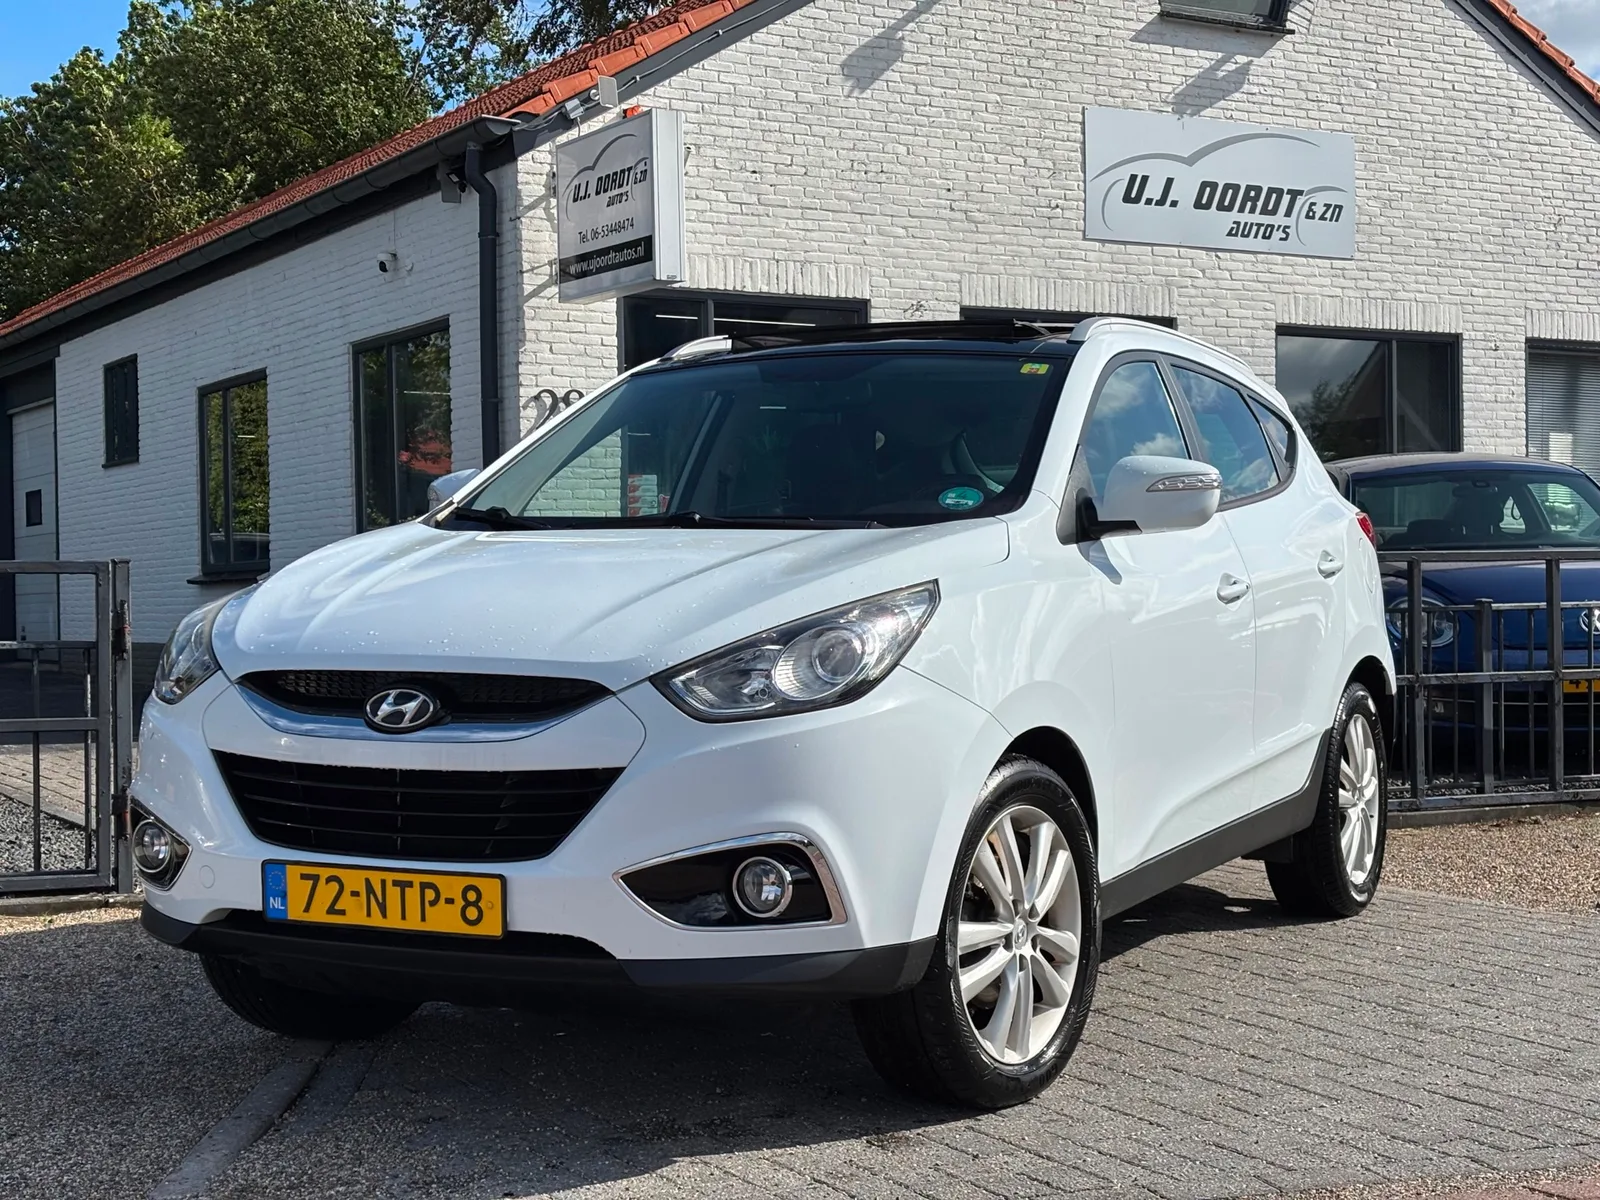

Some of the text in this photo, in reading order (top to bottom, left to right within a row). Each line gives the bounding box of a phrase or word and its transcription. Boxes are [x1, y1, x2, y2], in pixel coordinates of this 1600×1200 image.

[572, 181, 591, 203] U.J.
[595, 166, 634, 196] OORDT
[1121, 174, 1180, 208] U.J.
[1193, 180, 1305, 218] OORDT
[578, 217, 635, 244] Tel. 06-53448474
[1225, 220, 1291, 242] AUTO'S
[569, 242, 645, 273] www.ujoordtautos.nl
[269, 896, 285, 910] NL
[299, 873, 484, 926] 72-NTP-8
